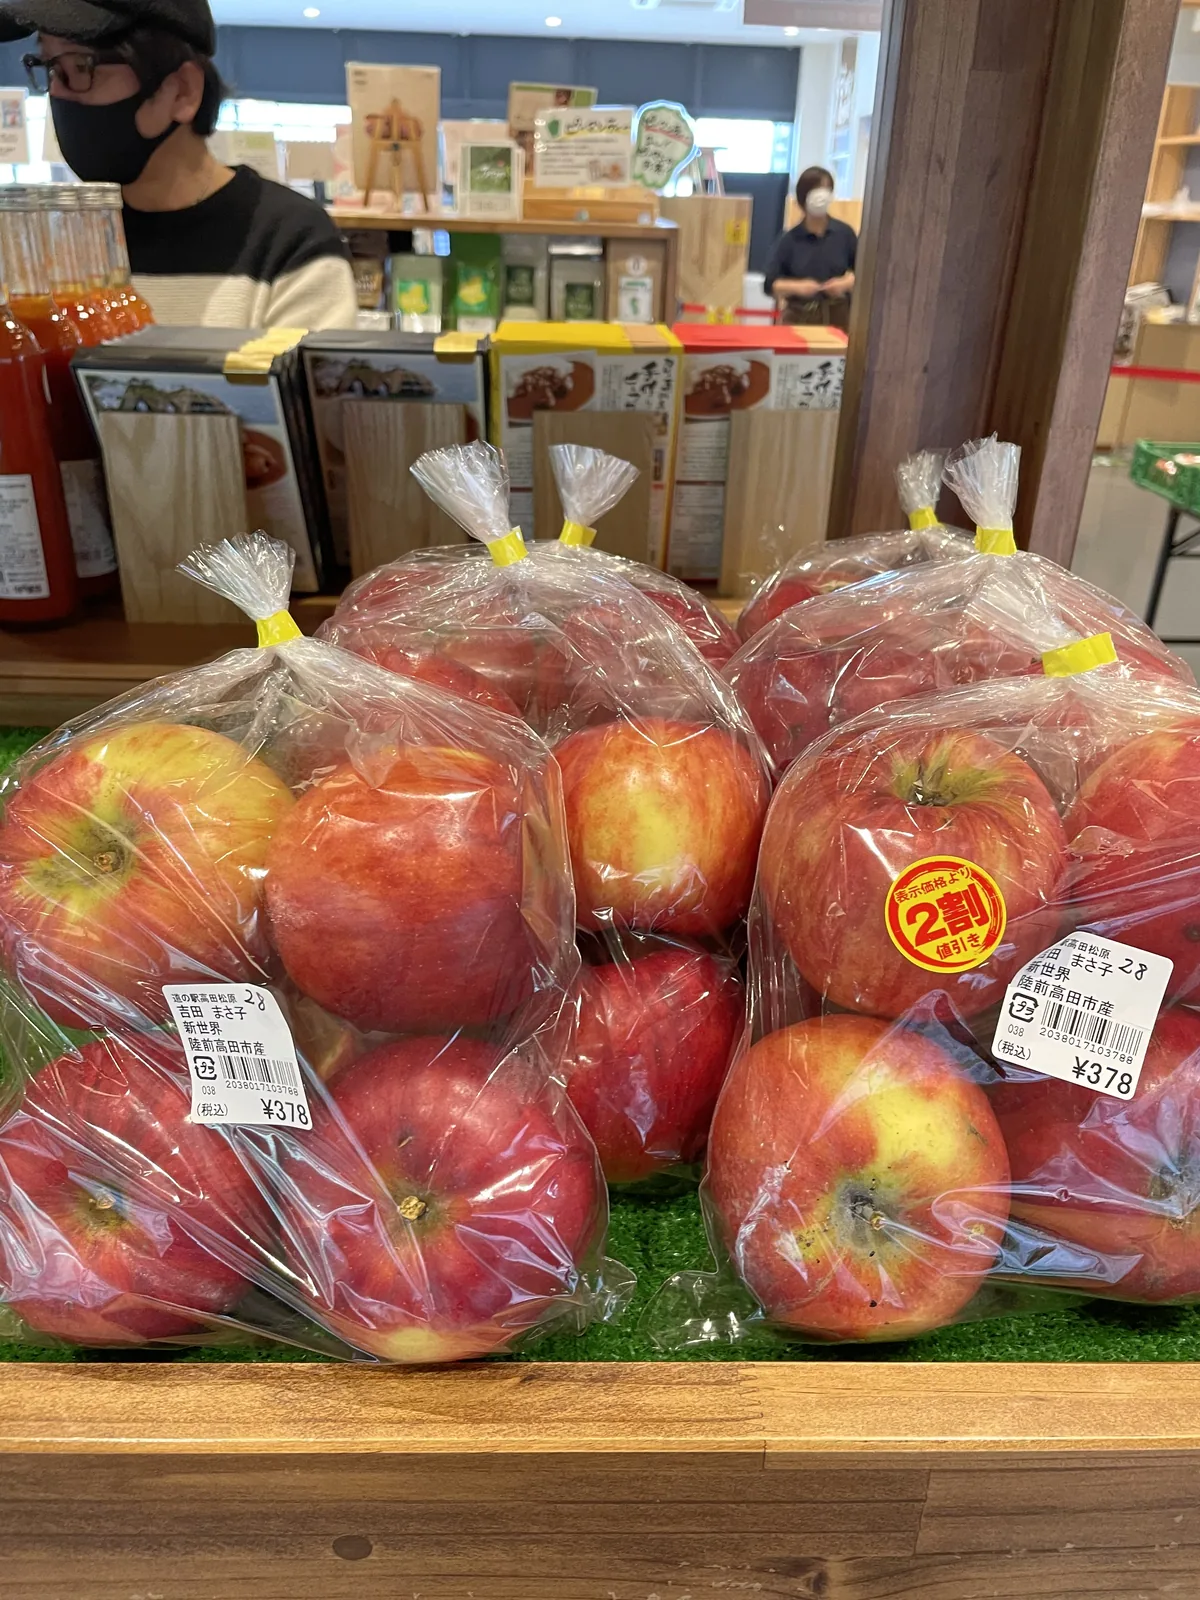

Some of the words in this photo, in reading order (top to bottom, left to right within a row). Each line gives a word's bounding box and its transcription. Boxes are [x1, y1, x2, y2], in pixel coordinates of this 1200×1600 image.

[894, 867, 972, 903] 表示価格より
[906, 883, 990, 948] 2割
[936, 933, 982, 960] 値引き
[1025, 961, 1071, 982] 新世界
[1072, 953, 1114, 977] まさ子
[1118, 958, 1148, 981] 28
[171, 993, 238, 1004] 道の駅高田松原
[244, 989, 266, 1011] 28
[1017, 974, 1115, 1017] 陸前高田市産
[176, 1005, 204, 1019] 吉田
[211, 1005, 247, 1021] まさ子
[183, 1021, 223, 1036] 新世界
[1007, 1024, 1025, 1037] 038
[188, 1038, 266, 1056] 陸前高田市産
[997, 1039, 1032, 1061] (税込)
[1039, 1027, 1134, 1065] 2038017103788
[1072, 1056, 1133, 1095] ¥378
[201, 1085, 216, 1095] 038
[226, 1080, 299, 1096] 2038017103788
[196, 1103, 228, 1117] (税込)
[260, 1098, 309, 1125] ¥378
